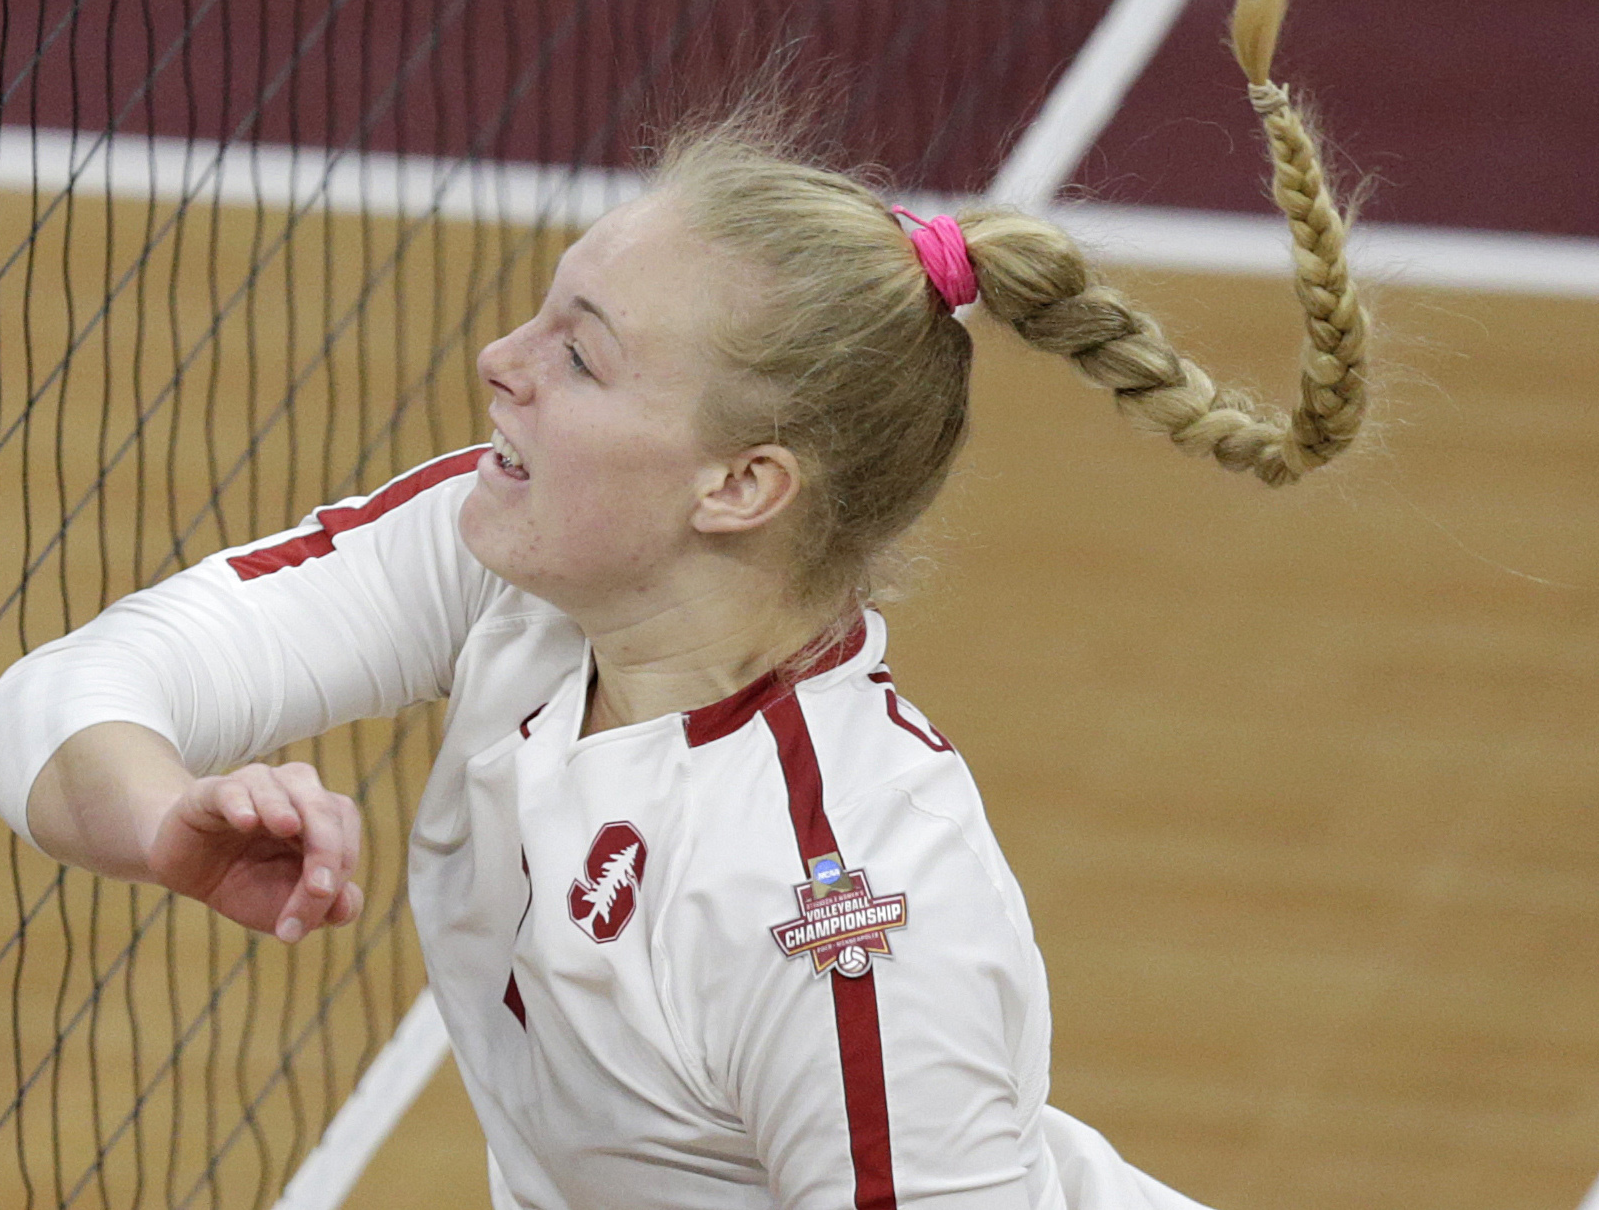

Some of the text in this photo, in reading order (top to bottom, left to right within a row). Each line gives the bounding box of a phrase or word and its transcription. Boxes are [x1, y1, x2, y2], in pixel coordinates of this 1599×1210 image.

[817, 868, 840, 880] NCAA
[806, 896, 870, 923] VOLLEYBALL
[785, 903, 901, 949] CHAMPIONSHIP
